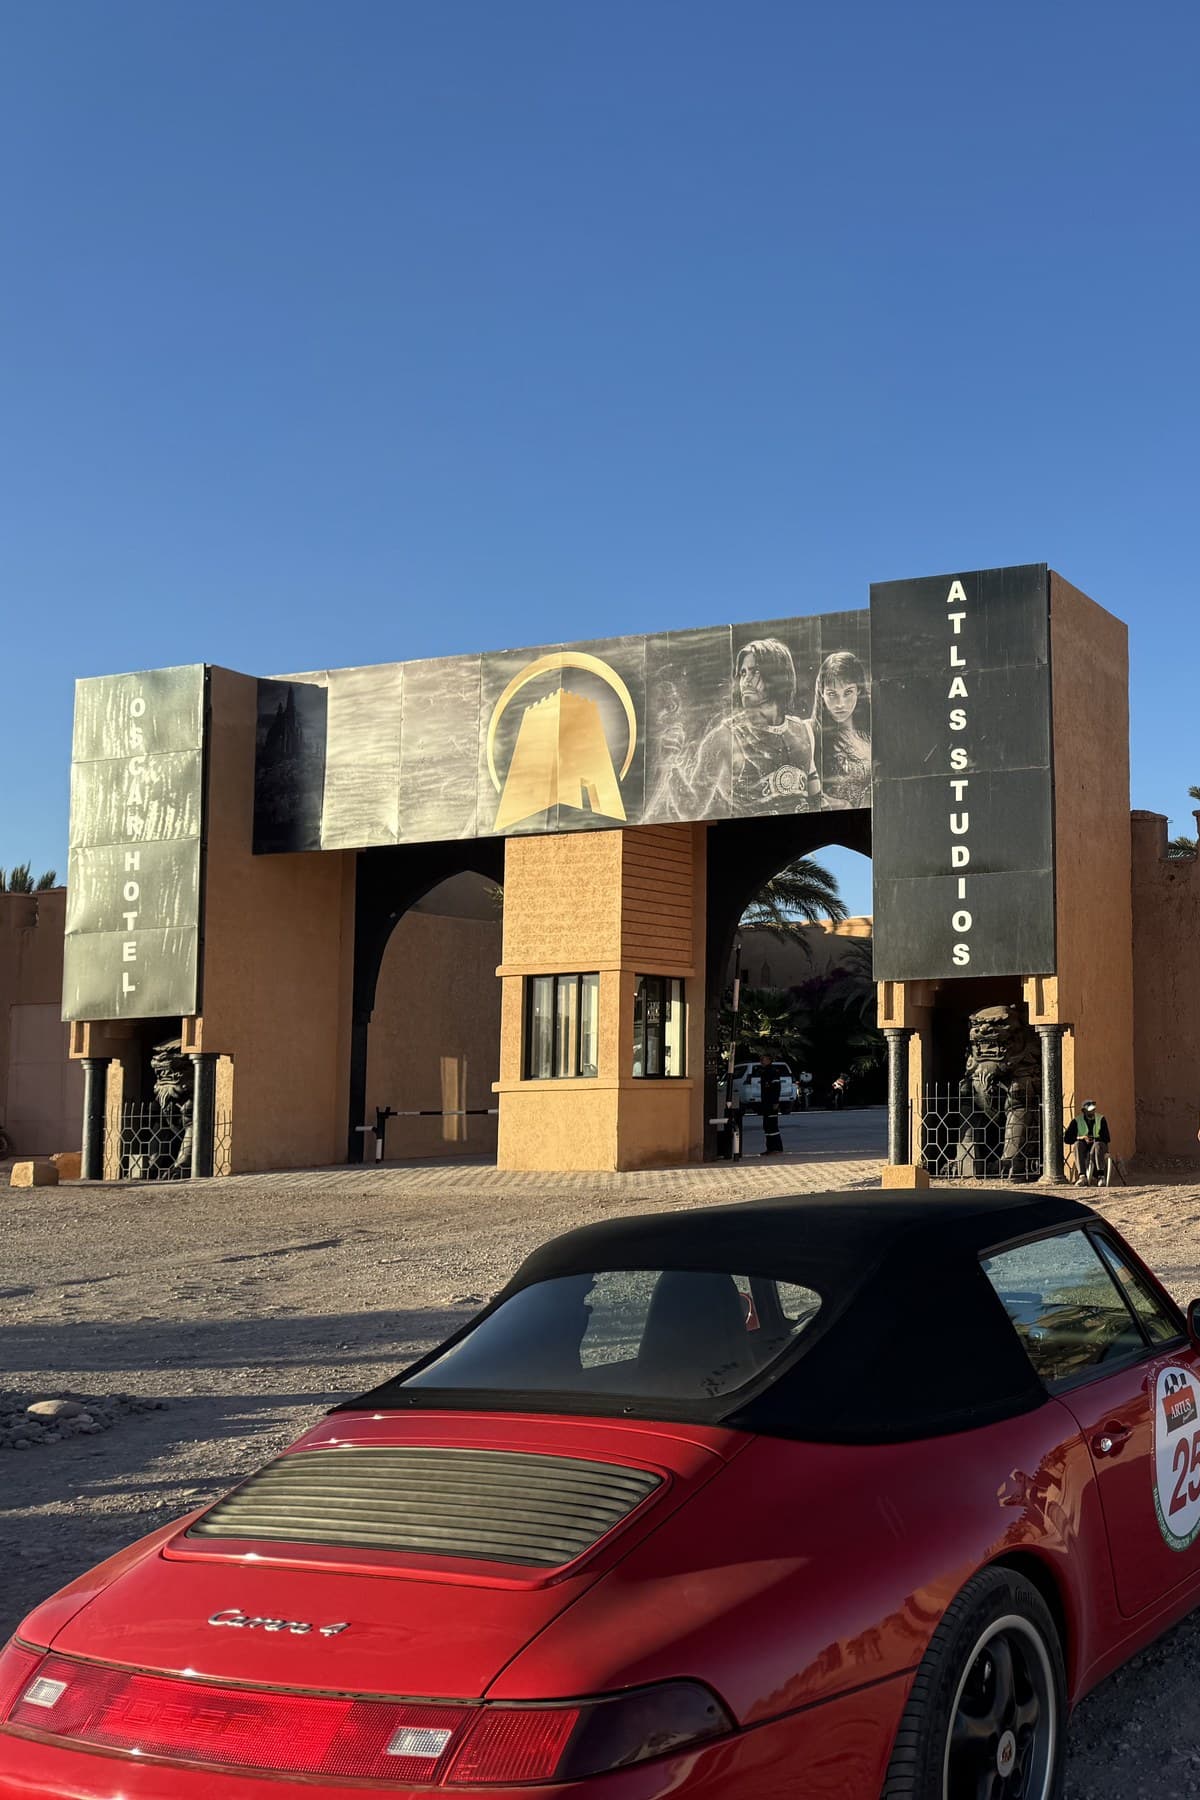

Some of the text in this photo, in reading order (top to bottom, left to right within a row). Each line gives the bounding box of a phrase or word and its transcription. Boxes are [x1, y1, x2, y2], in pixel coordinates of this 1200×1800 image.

[122, 697, 146, 992] OSCAR HOTEL
[946, 580, 973, 966] ATLAS STUDIOS
[1170, 1397, 1192, 1421] ARTUS
[207, 1609, 352, 1637] Carrera 4
